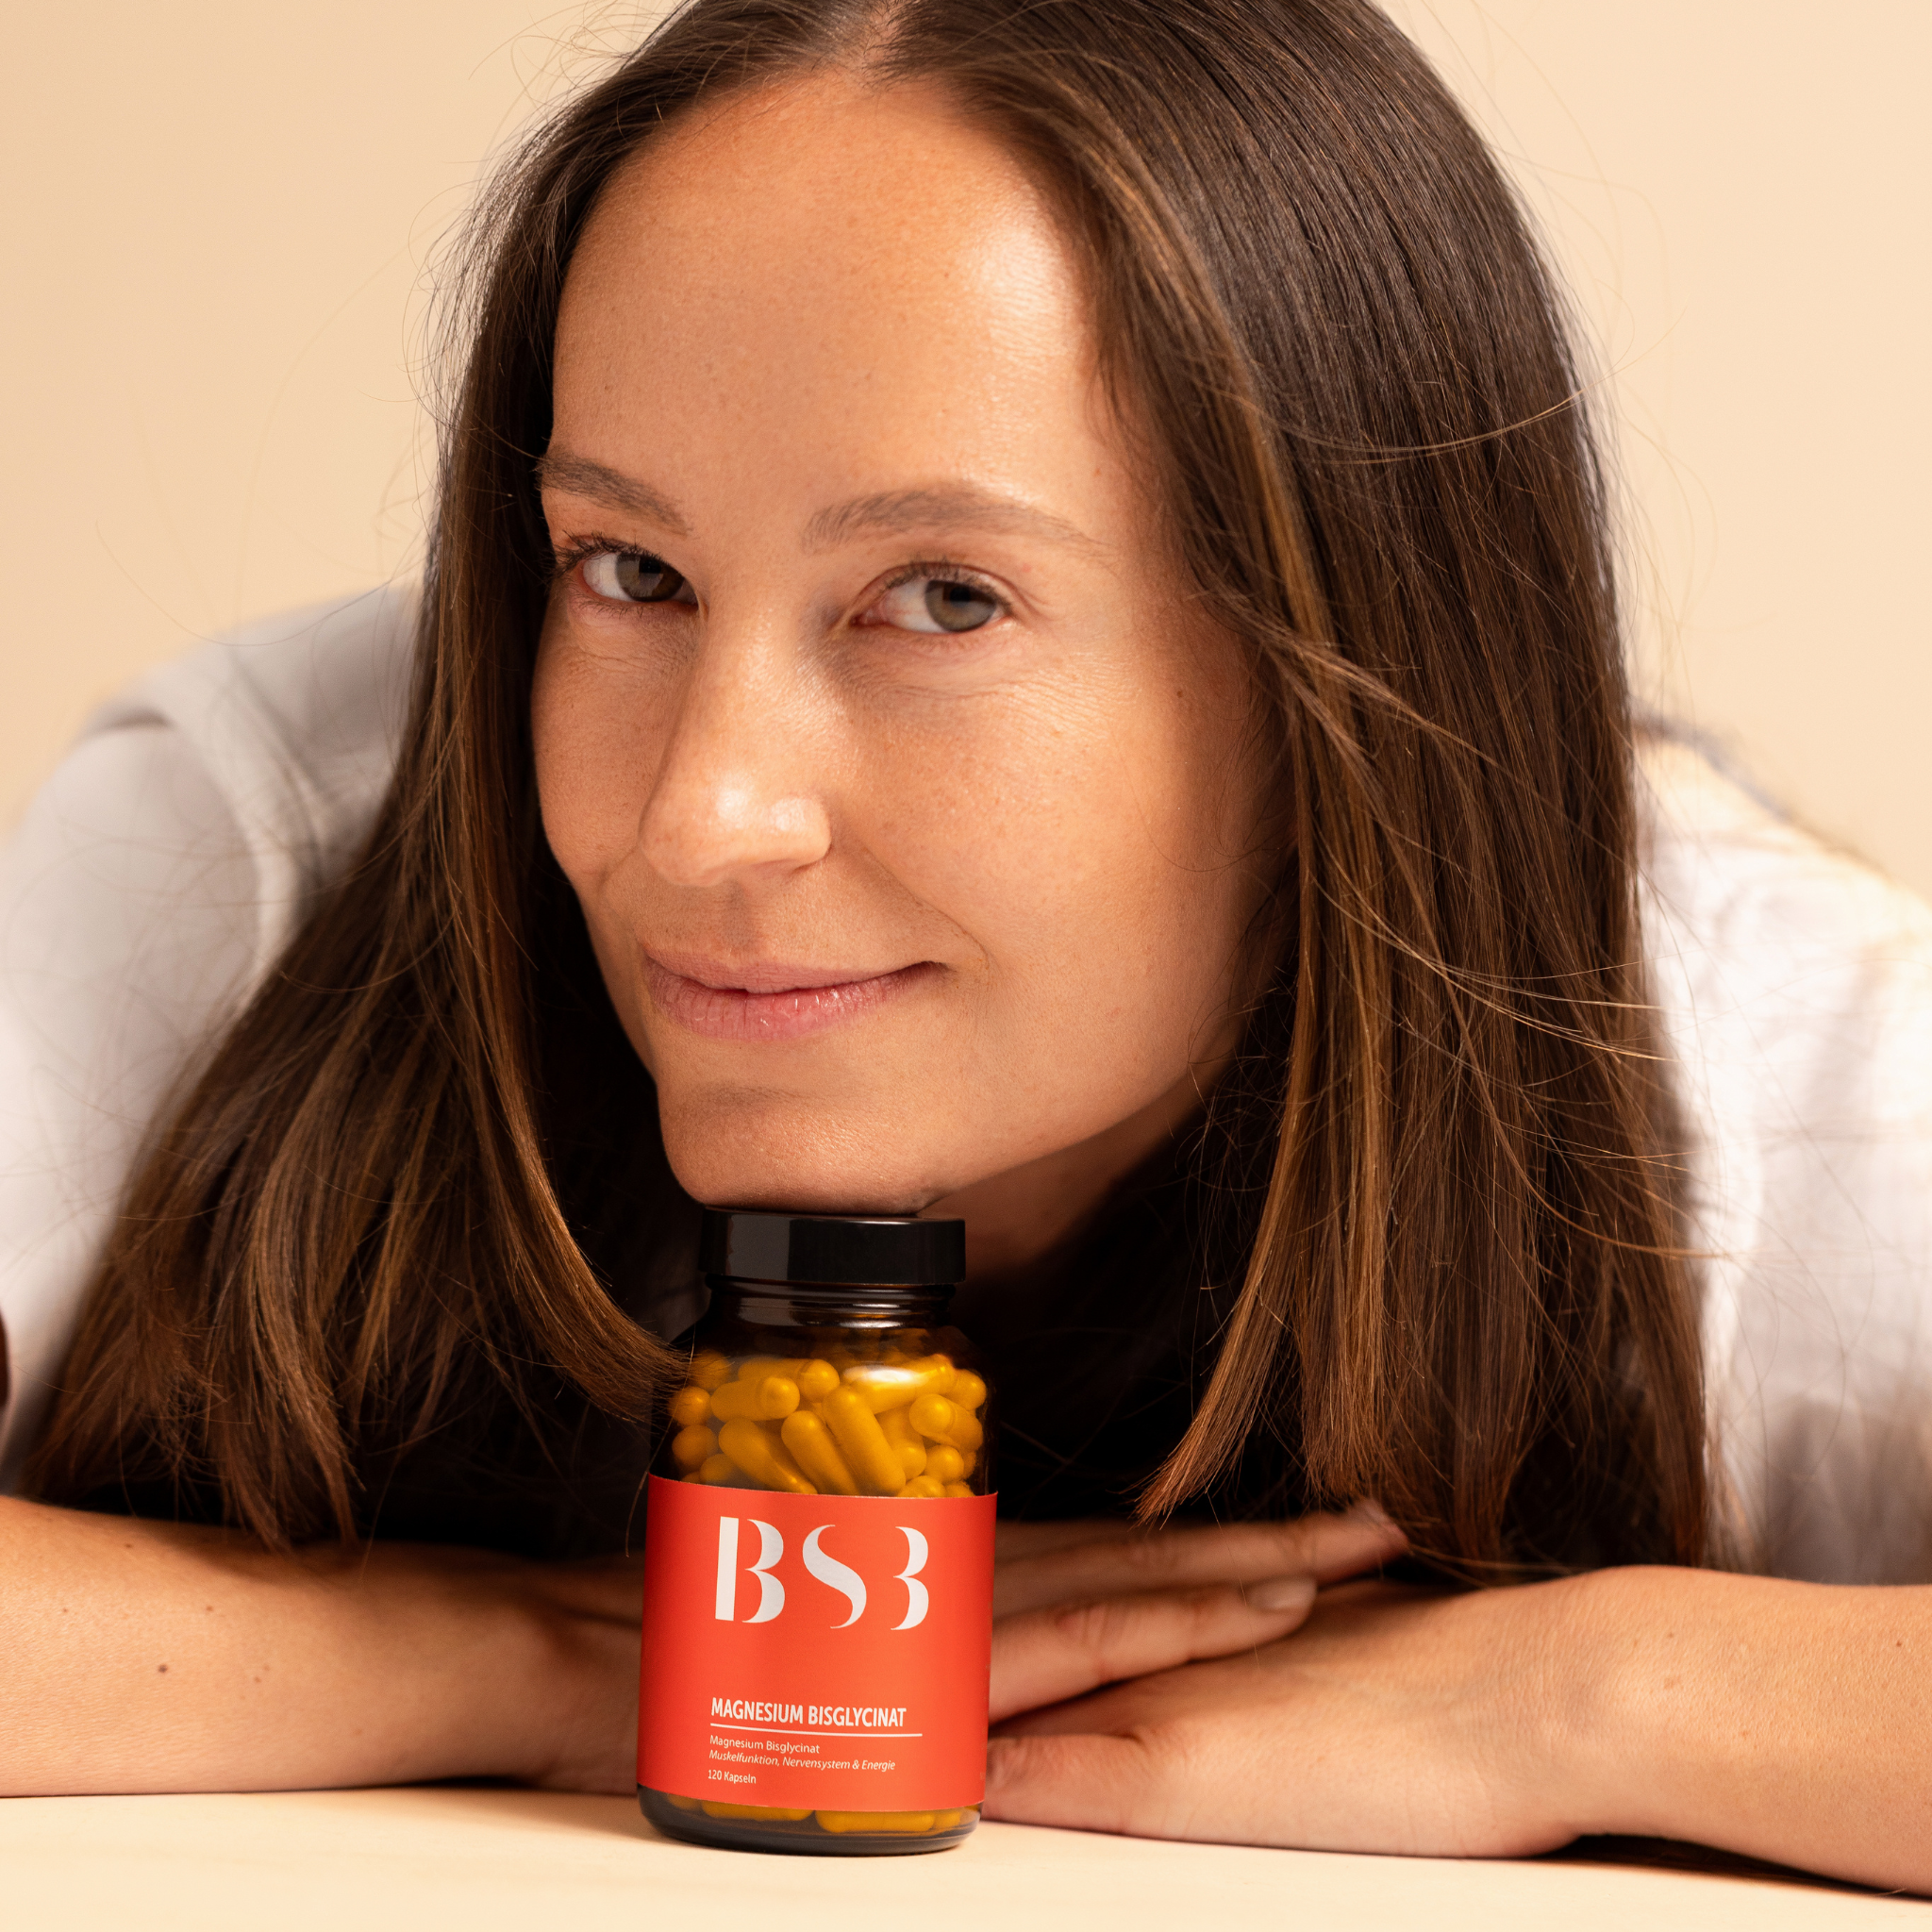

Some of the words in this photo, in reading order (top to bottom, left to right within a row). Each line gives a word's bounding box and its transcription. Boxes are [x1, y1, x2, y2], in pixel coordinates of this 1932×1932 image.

[710, 1696, 804, 1724] MAGNESIUM
[808, 1705, 908, 1728] BISGLYCINAT
[709, 1734, 764, 1751] Magnesium
[766, 1740, 821, 1755] Bisglycinat
[708, 1749, 780, 1768] Muskelfunktion,
[782, 1756, 851, 1772] Nervensystem
[851, 1758, 860, 1771] &
[860, 1759, 896, 1773] Energie
[708, 1769, 723, 1782] 120
[724, 1770, 757, 1785] Kapseln
